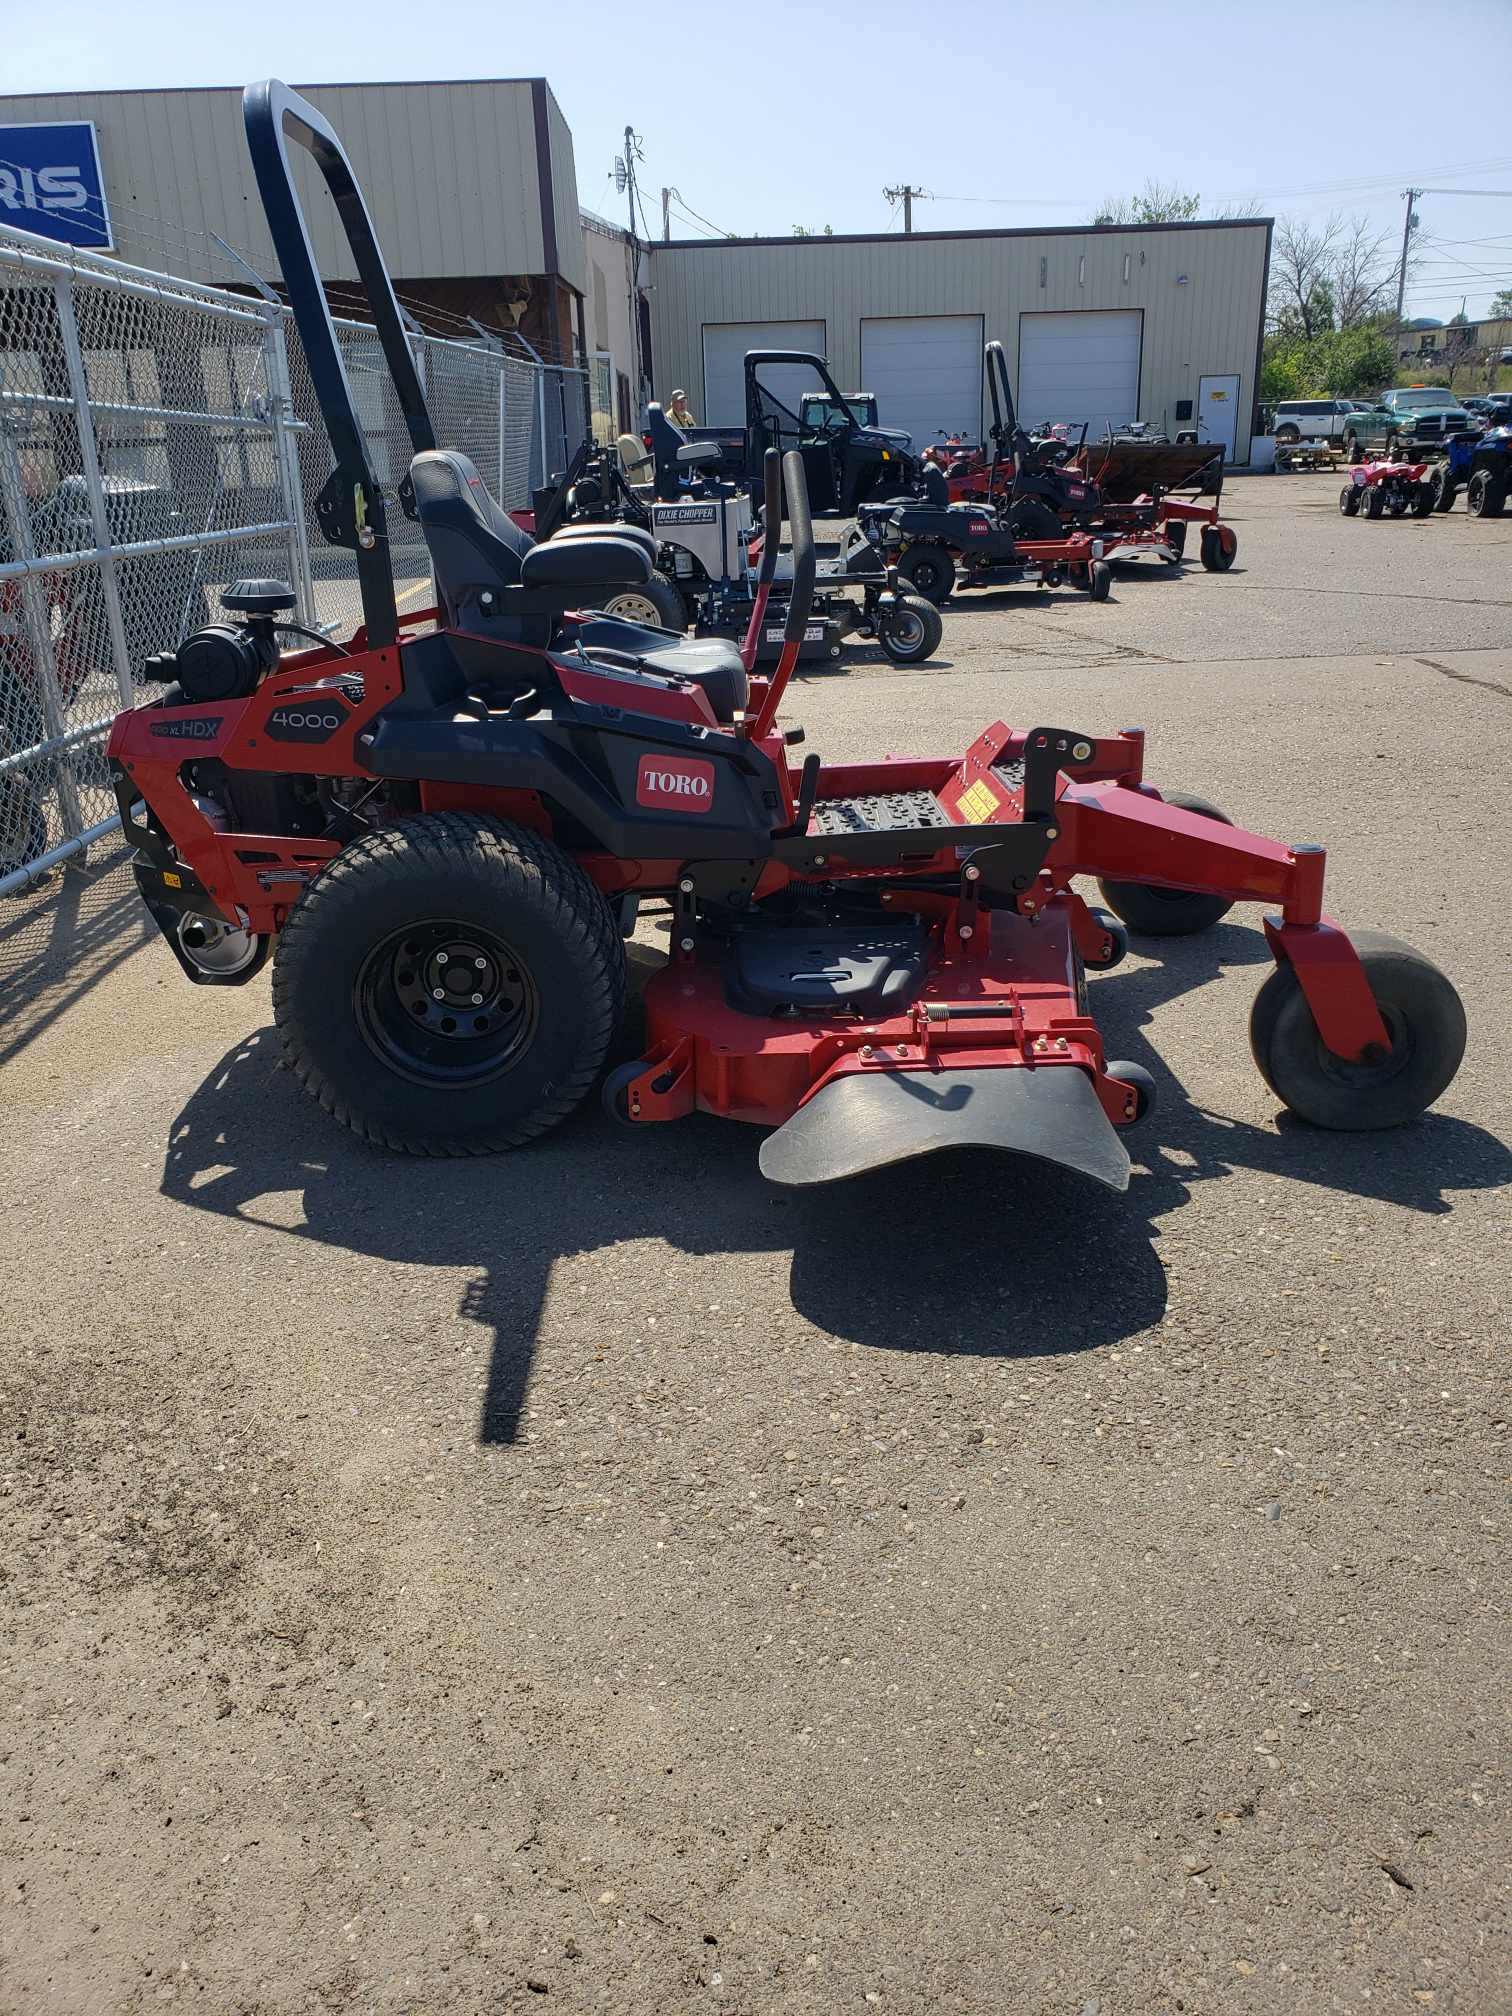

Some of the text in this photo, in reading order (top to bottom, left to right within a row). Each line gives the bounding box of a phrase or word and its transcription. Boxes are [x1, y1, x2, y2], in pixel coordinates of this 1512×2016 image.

[657, 507, 713, 520] DIXIE CHOPPER
[181, 720, 217, 737] HDX
[272, 712, 339, 729] 4000
[644, 771, 708, 796] TORO
